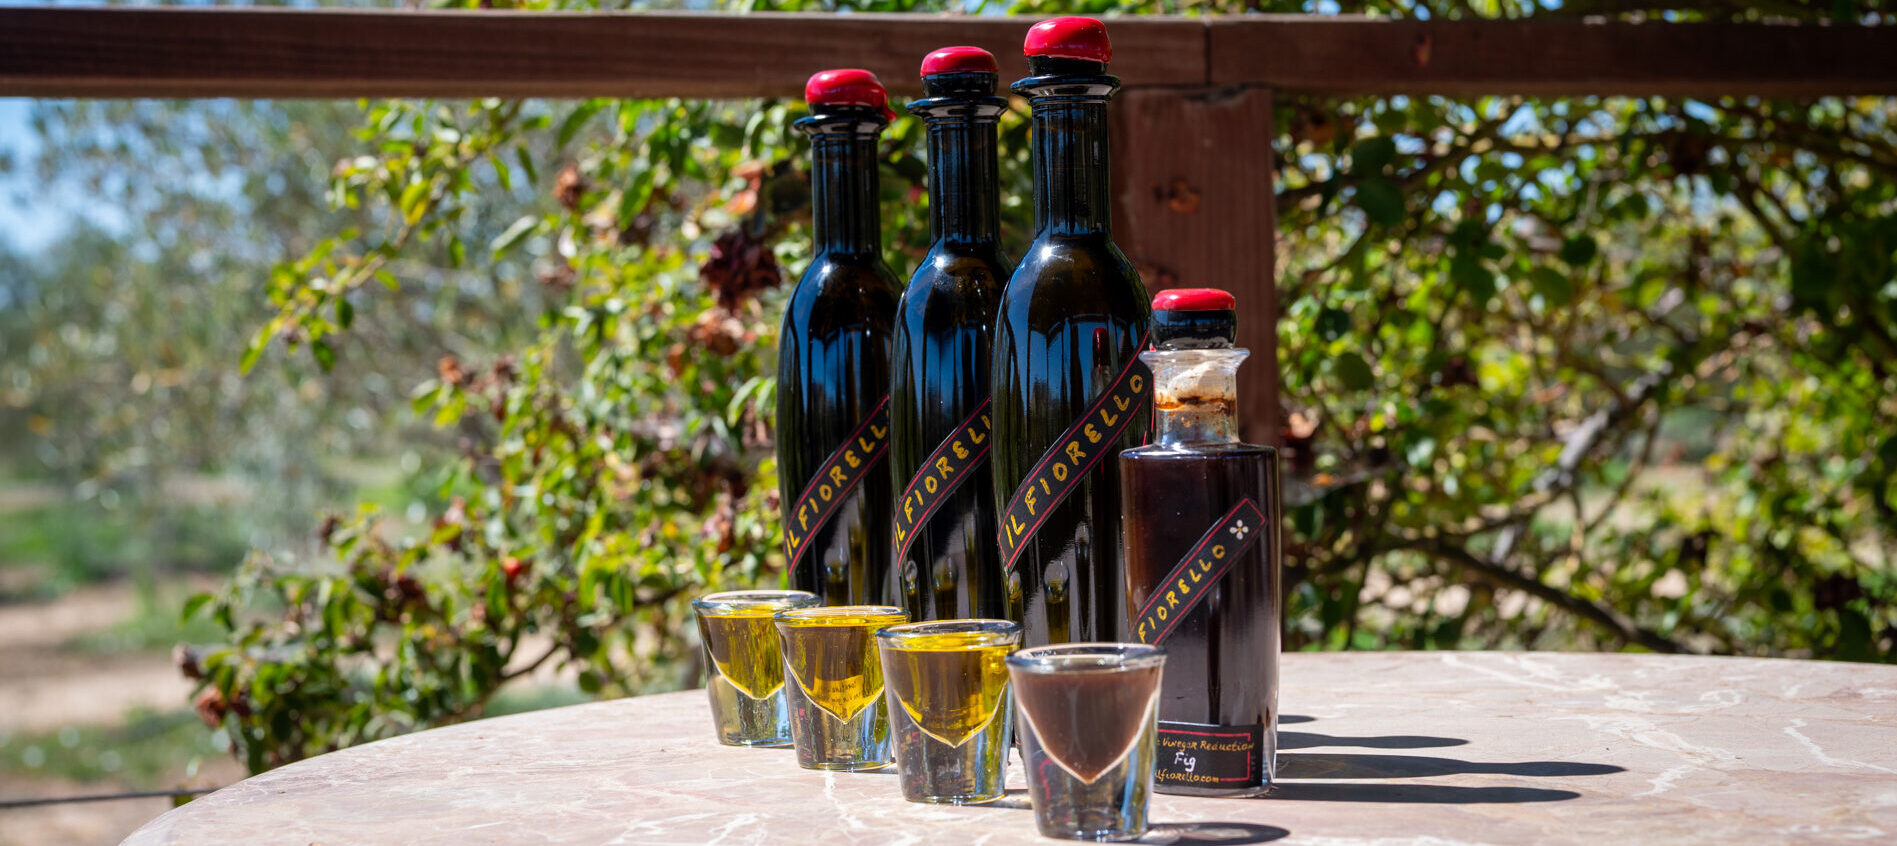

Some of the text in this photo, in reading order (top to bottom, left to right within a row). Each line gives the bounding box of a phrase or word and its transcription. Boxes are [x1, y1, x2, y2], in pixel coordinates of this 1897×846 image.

[786, 409, 889, 559] IL FIORELL
[1005, 374, 1143, 549] IL FIORELLO
[894, 521, 906, 553] IL
[1138, 544, 1226, 644] FIORELLO
[1174, 751, 1197, 772] Fig
